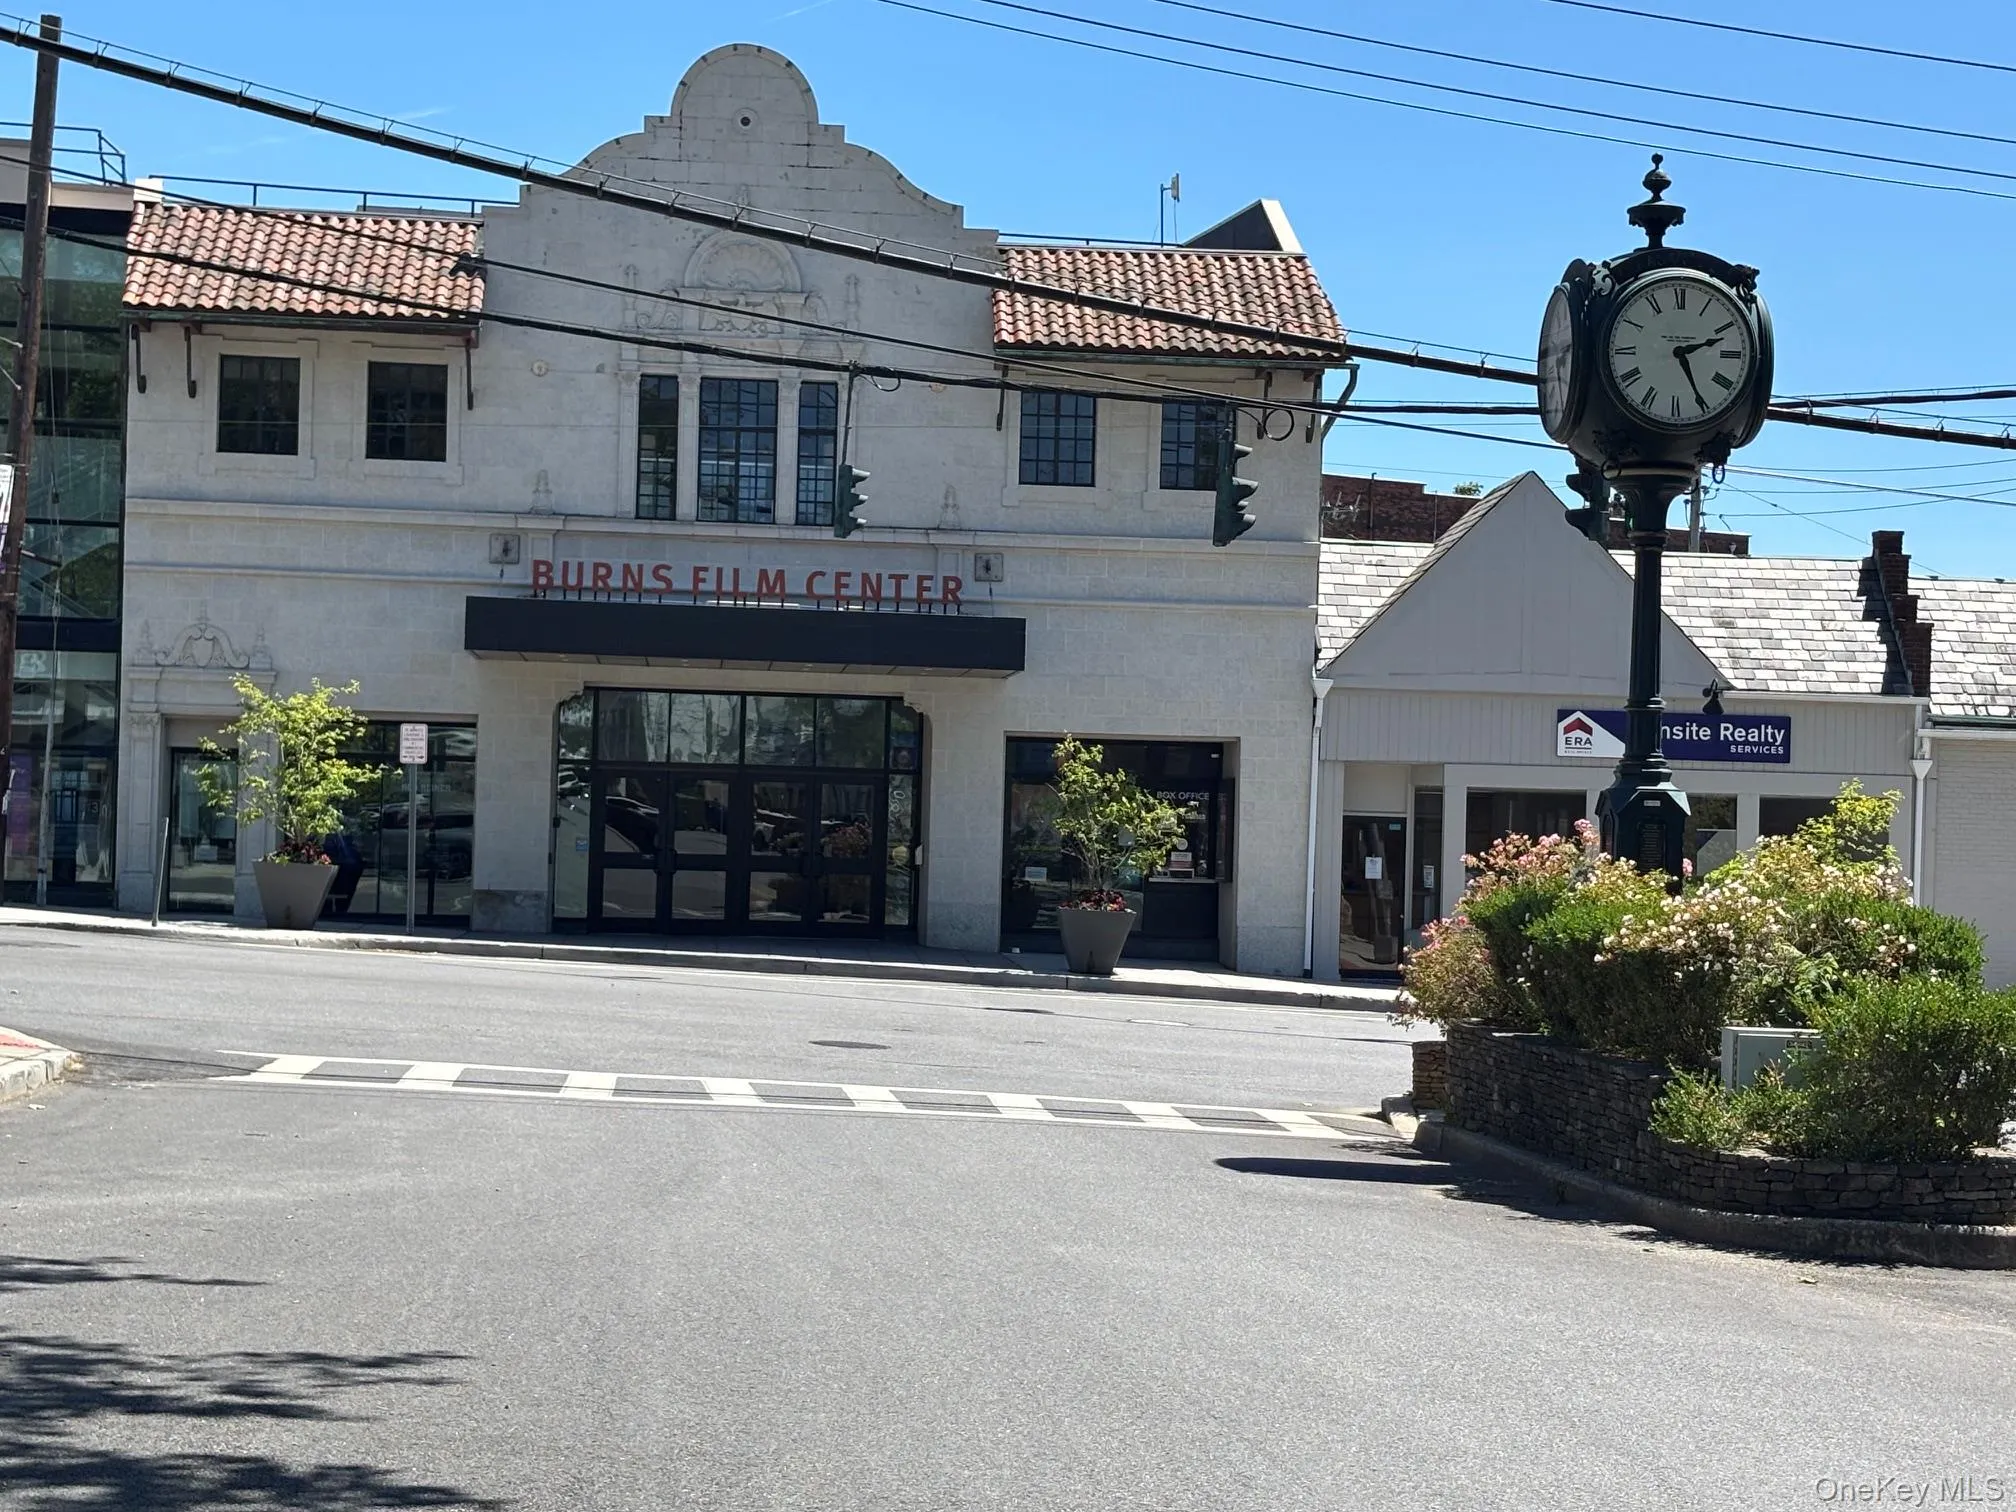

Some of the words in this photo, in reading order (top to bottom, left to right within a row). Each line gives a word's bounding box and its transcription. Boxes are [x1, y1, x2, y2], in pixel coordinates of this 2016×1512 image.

[1673, 286, 1686, 310] XII
[1719, 350, 1741, 359] III
[532, 559, 673, 594] BURNS
[692, 565, 786, 599] FILM
[805, 570, 964, 606] CENTER
[1720, 723, 1785, 746] Realty
[1564, 736, 1592, 746] ERA
[1730, 745, 1784, 754] SERVICES
[1156, 791, 1176, 799] BOX
[1178, 792, 1209, 800] OFFICE
